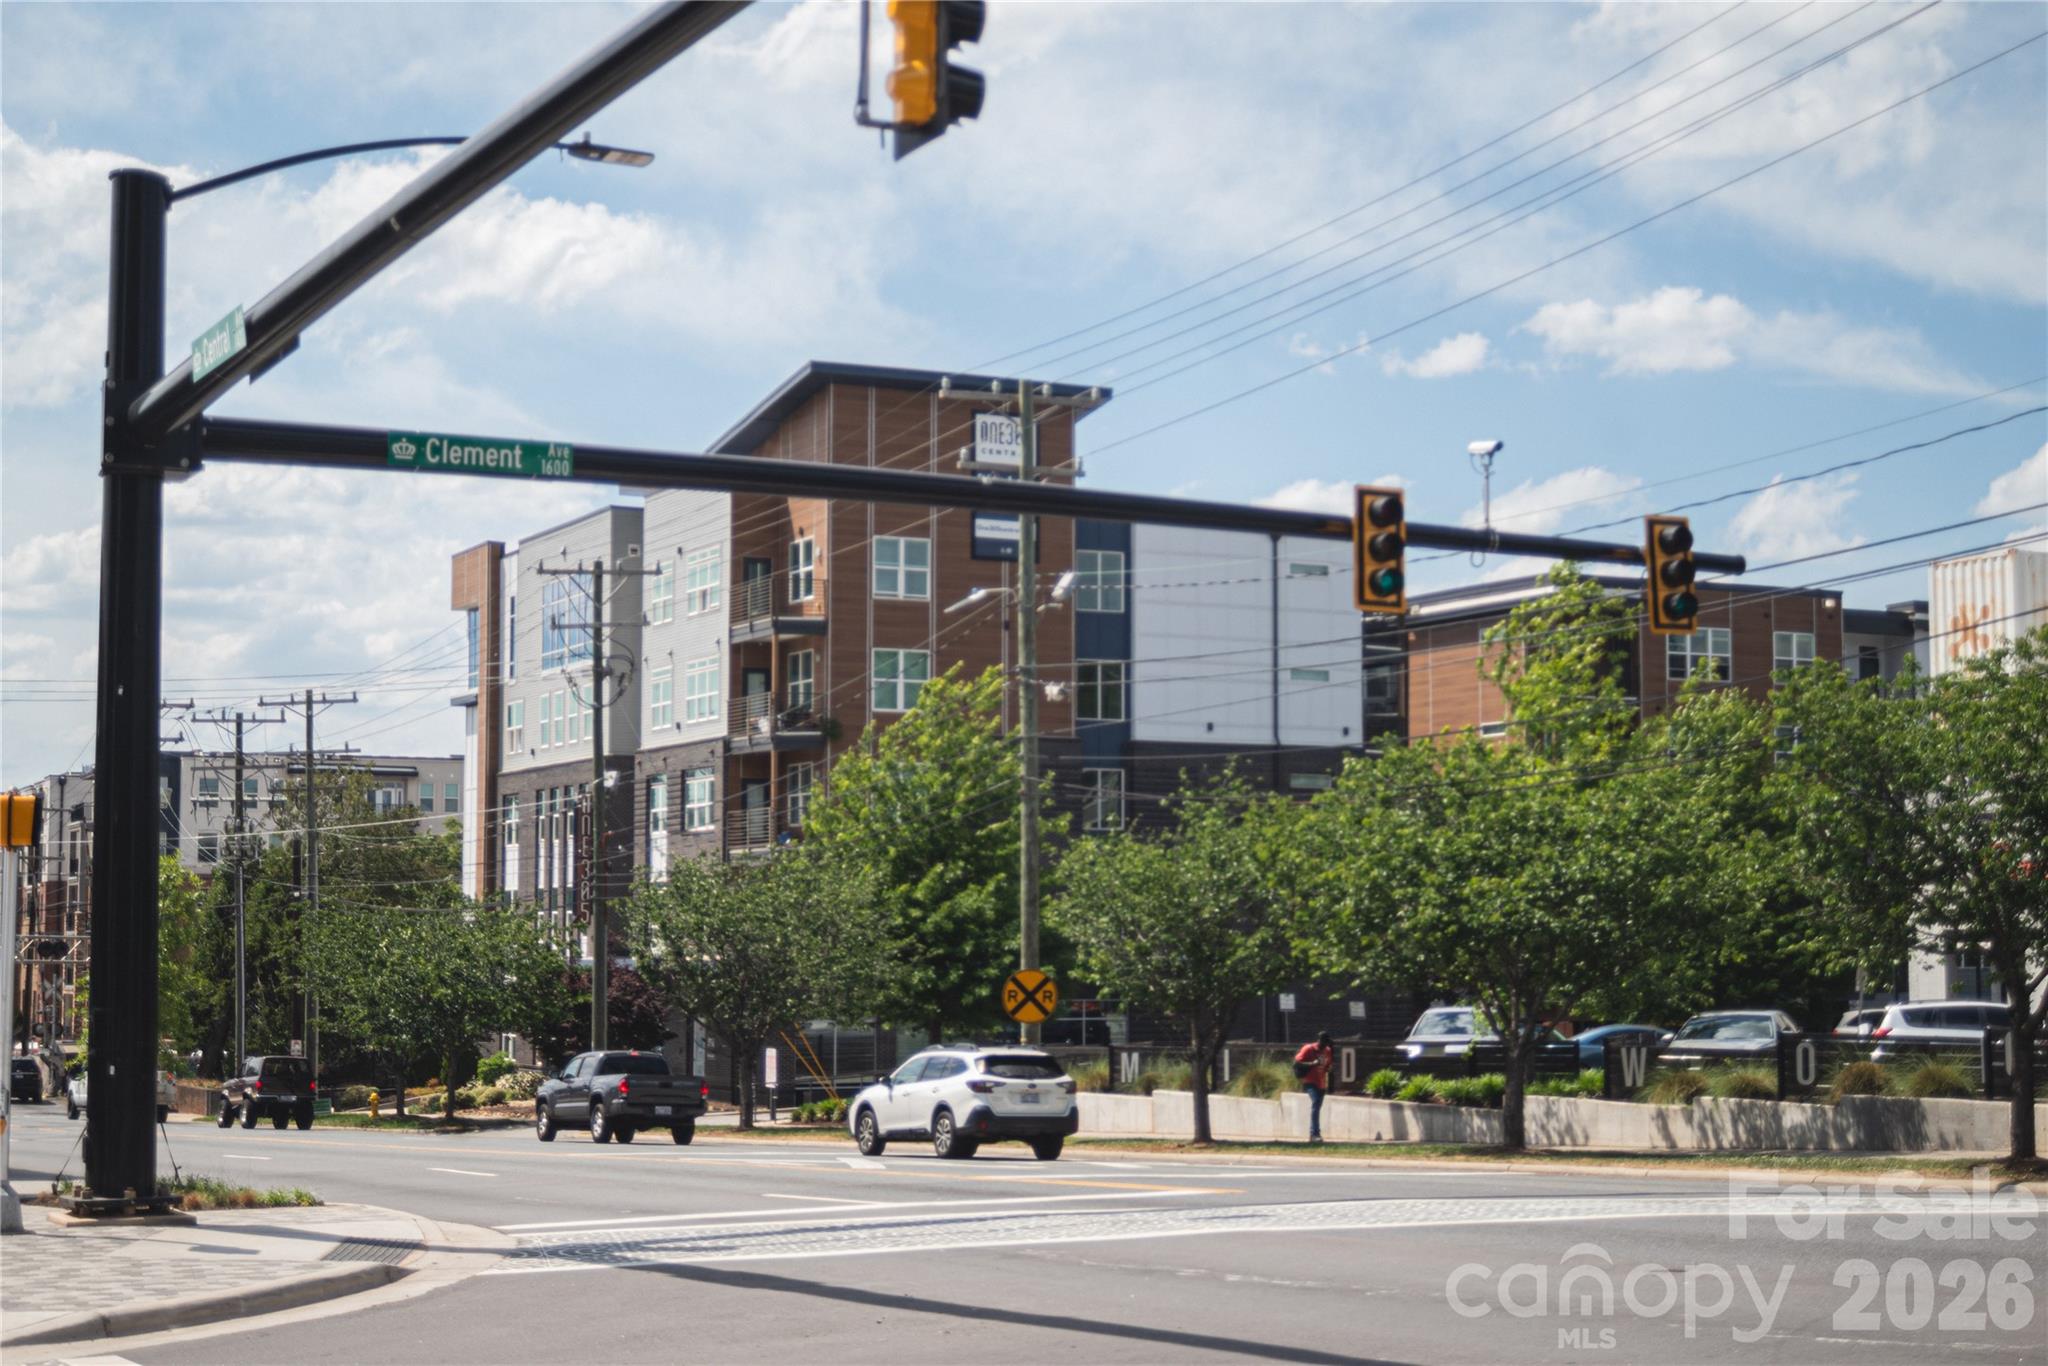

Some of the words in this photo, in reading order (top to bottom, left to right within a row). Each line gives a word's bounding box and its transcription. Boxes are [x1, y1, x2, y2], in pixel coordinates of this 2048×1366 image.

[426, 437, 523, 469] Clement
[549, 442, 570, 459] Ave
[541, 458, 570, 477] 1600
[1008, 990, 1018, 1003] R
[1043, 990, 1053, 1003] R
